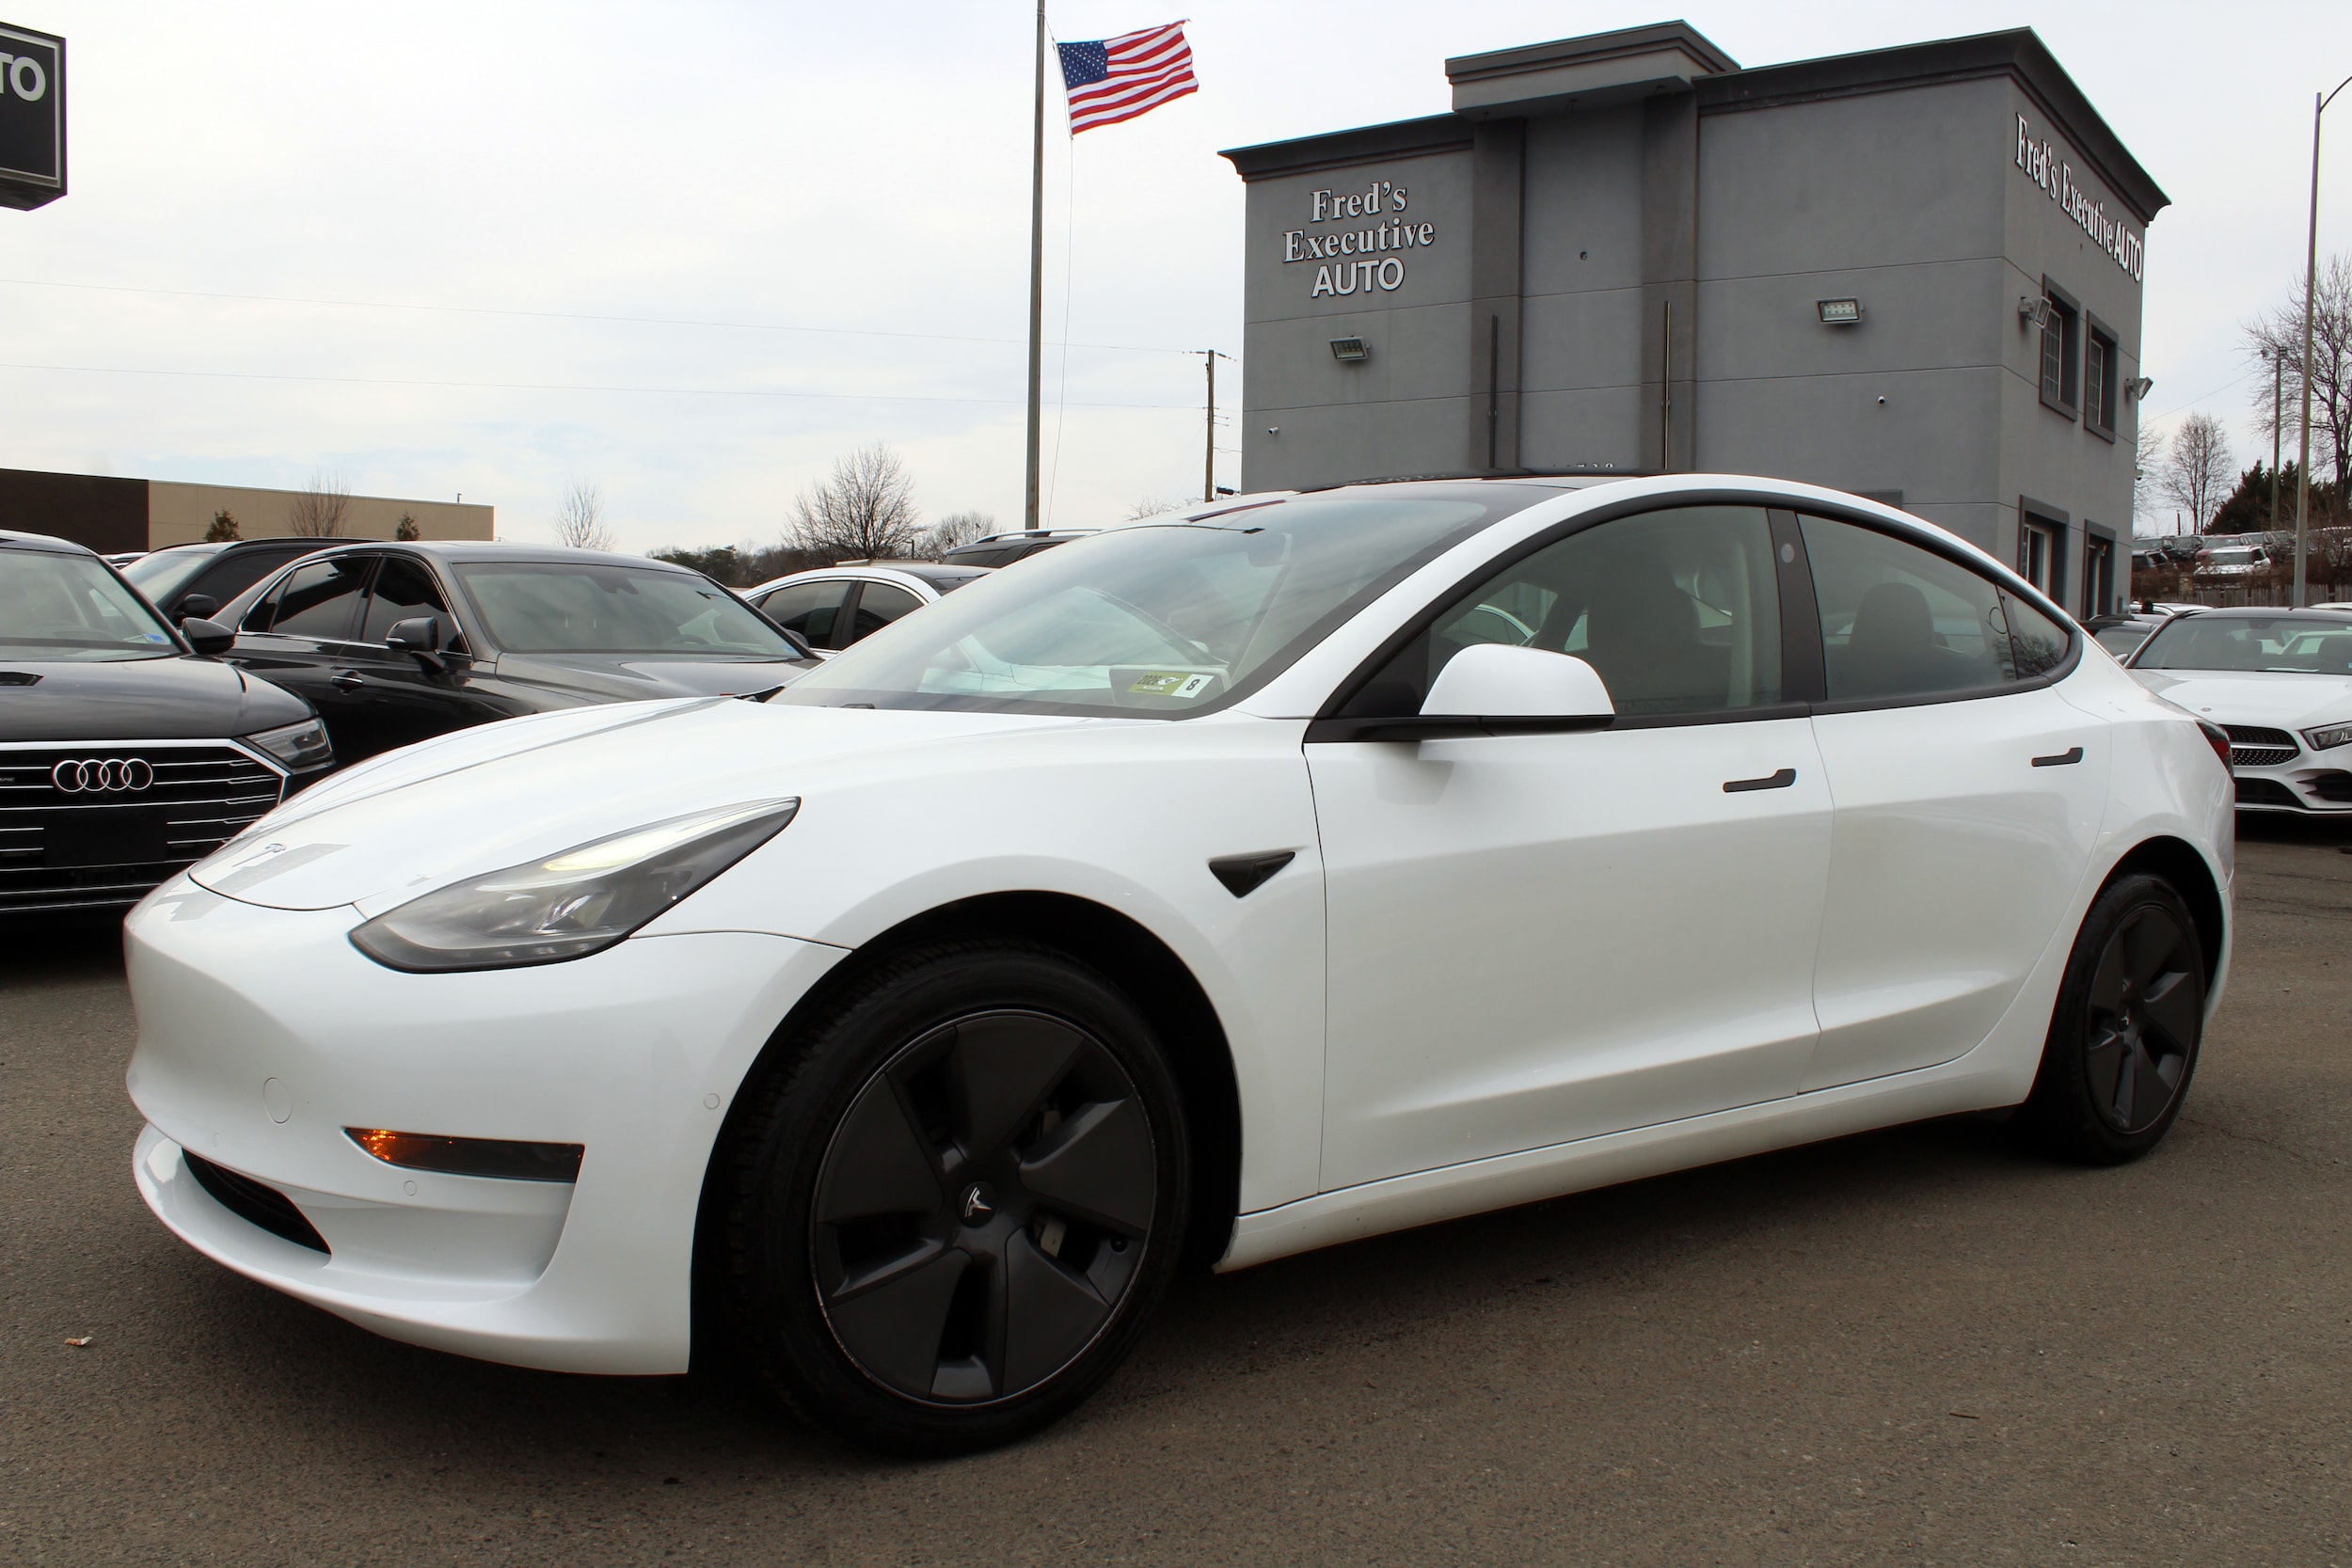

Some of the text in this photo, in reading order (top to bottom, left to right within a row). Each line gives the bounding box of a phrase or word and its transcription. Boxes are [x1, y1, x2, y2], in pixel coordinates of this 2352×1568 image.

[1310, 181, 1406, 222] Fred's
[2016, 112, 2142, 282] Fred's Executive AUTO
[1282, 217, 1434, 262] Executive
[1311, 257, 1405, 297] AUTO
[1185, 678, 1200, 691] 8
